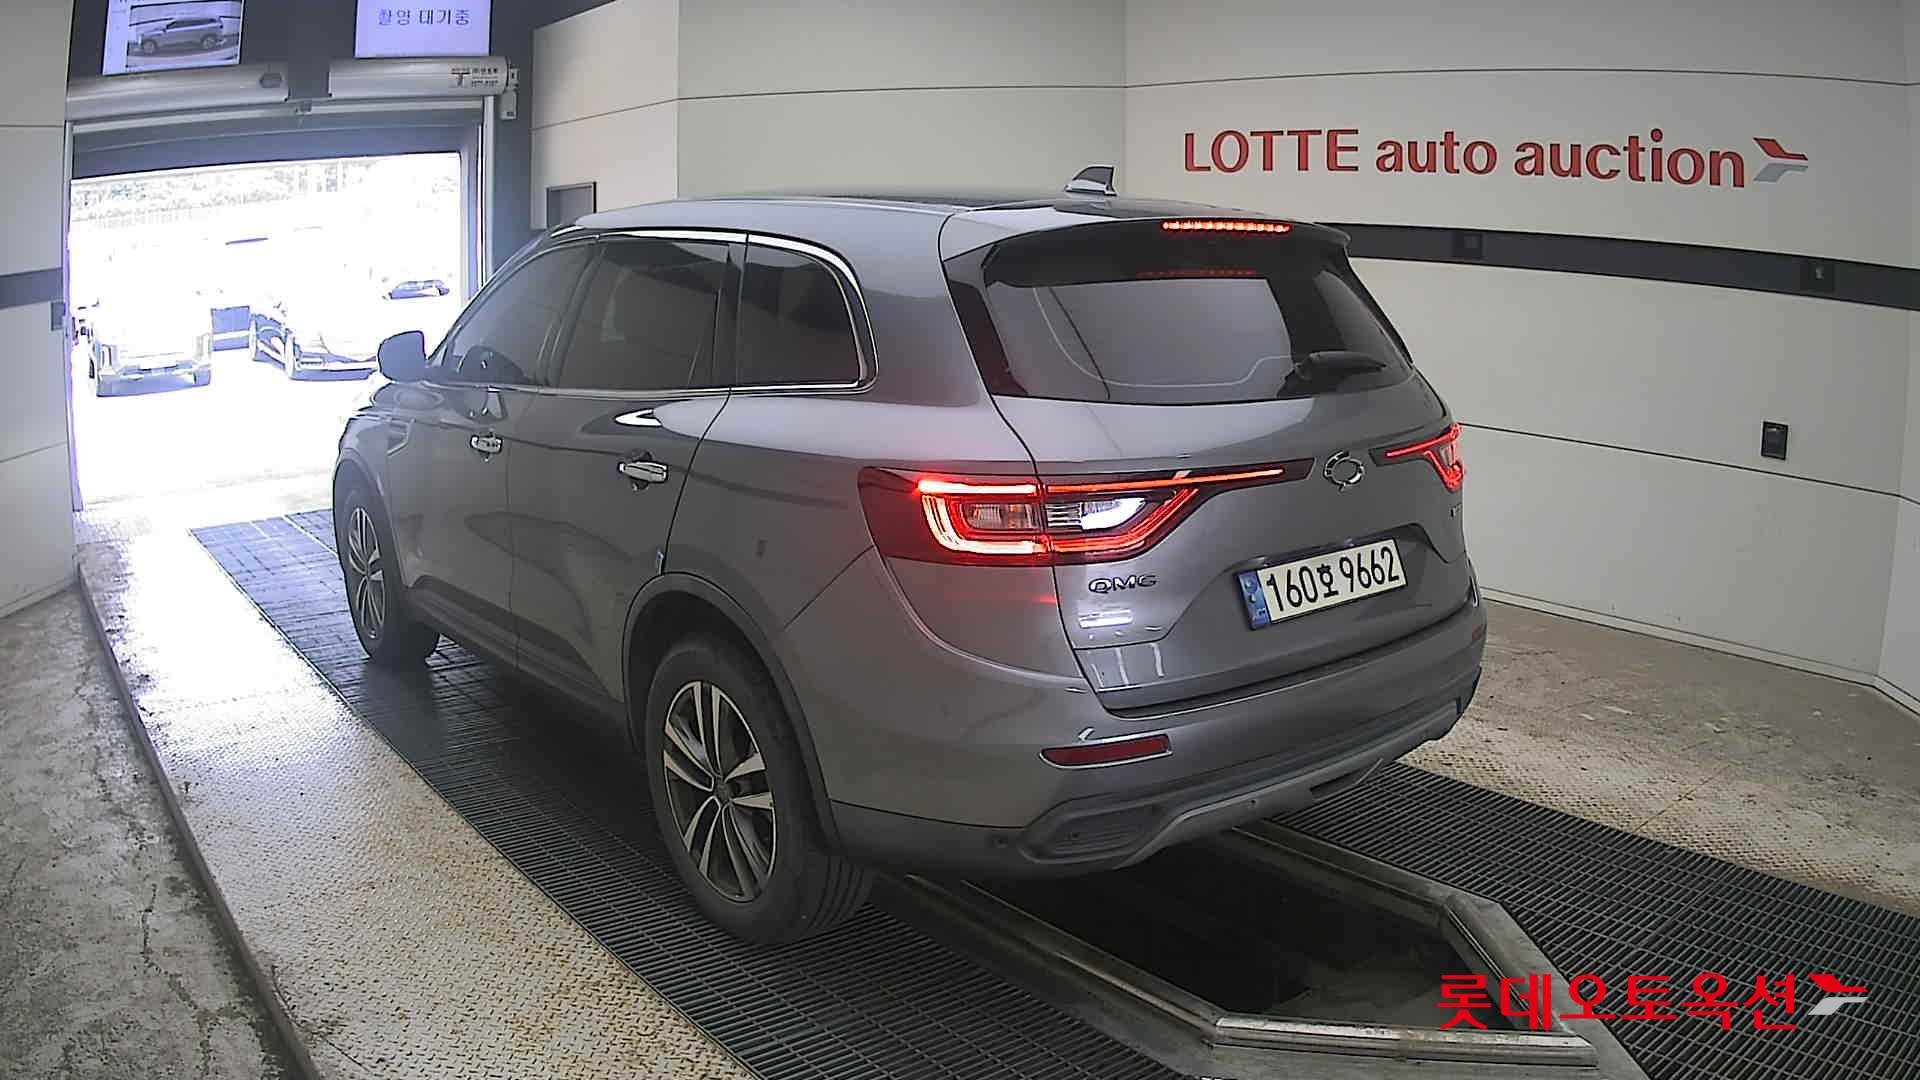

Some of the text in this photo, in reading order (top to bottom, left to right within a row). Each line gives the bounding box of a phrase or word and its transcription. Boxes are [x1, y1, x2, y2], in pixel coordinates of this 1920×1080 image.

[419, 9, 471, 26] 대기중
[1184, 128, 1745, 188] LOTTE auto auction
[1339, 546, 1400, 593] 9662
